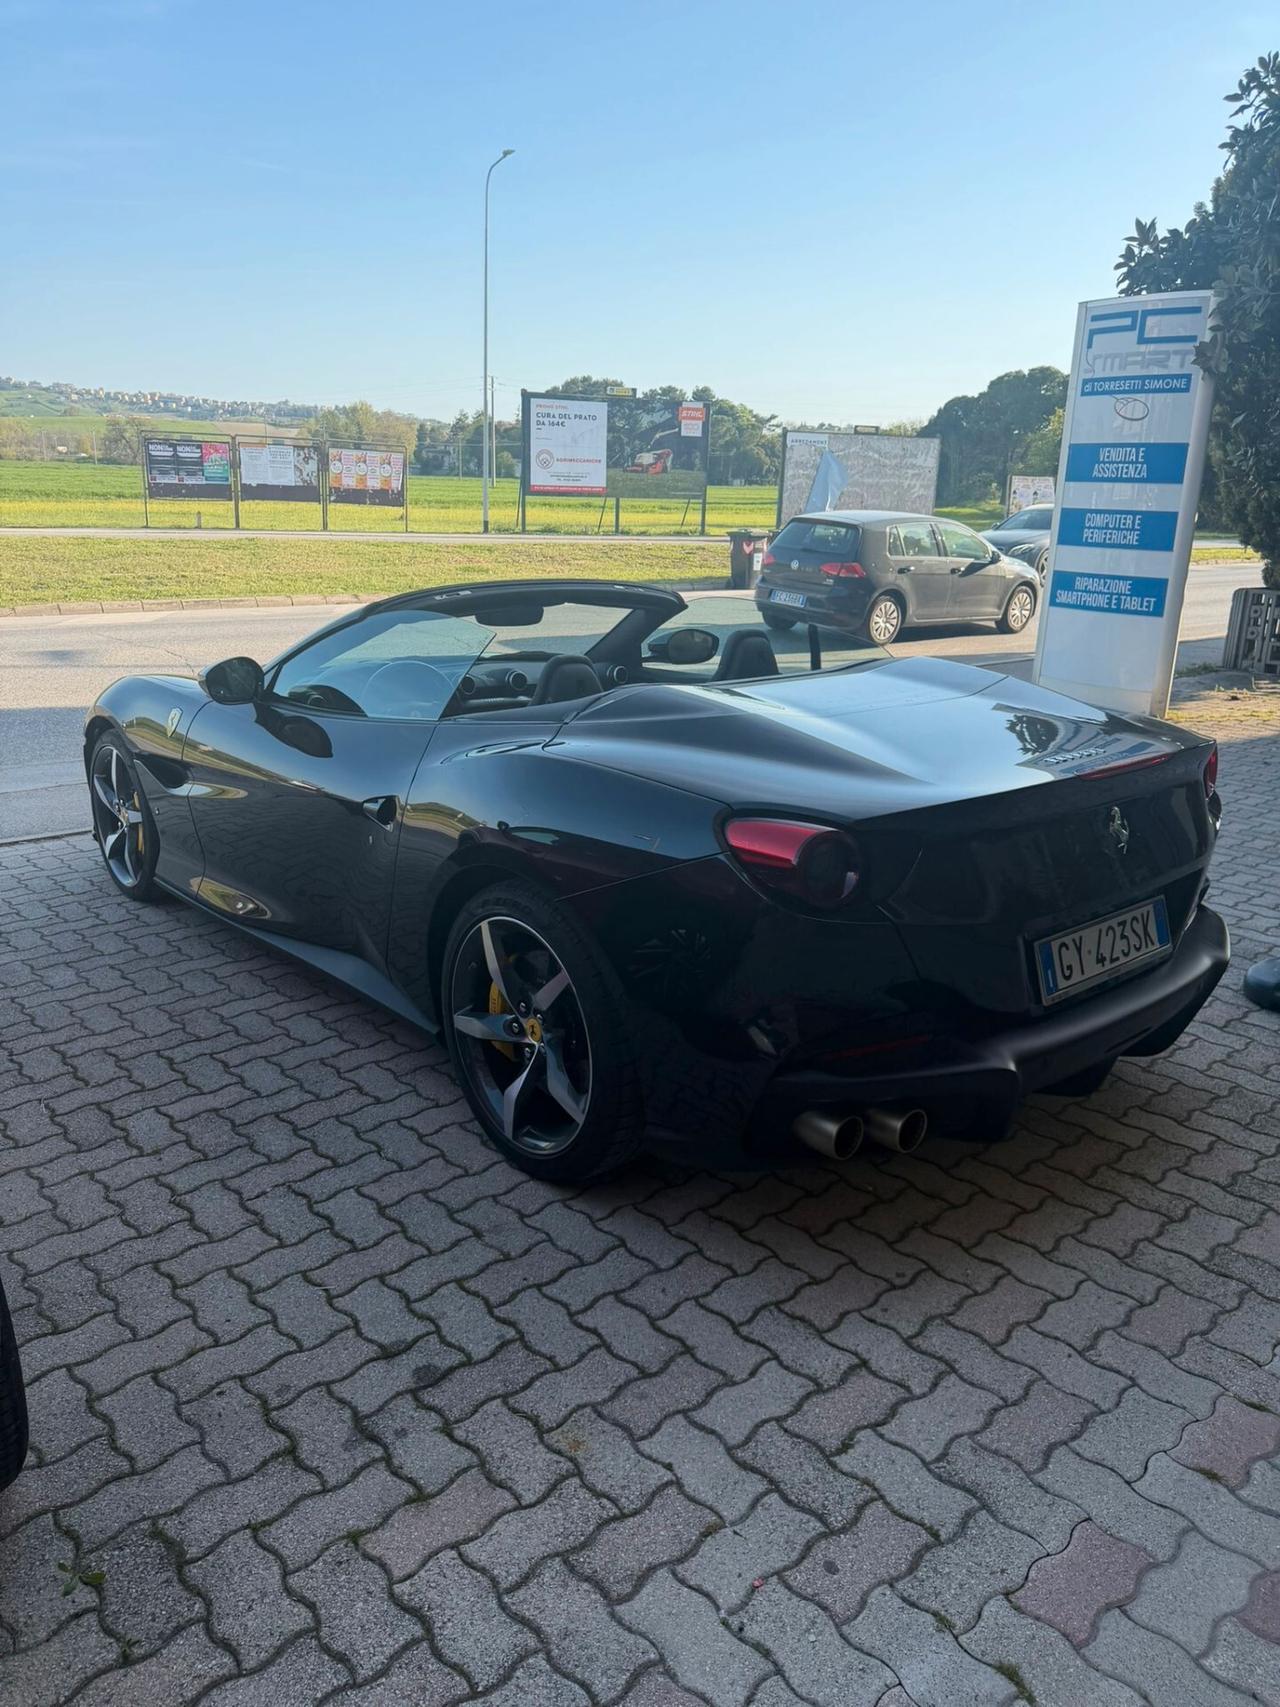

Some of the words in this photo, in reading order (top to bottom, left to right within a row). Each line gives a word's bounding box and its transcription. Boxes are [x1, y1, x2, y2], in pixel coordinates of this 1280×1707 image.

[1087, 306, 1202, 349] PC
[1084, 382, 1092, 392] di
[1094, 379, 1142, 392] TORRESETTI
[1144, 378, 1188, 390] SIMONE
[536, 411, 556, 420] CURA
[573, 413, 597, 421] PRATO
[681, 410, 703, 418] STIHL
[536, 419, 546, 427] DA
[548, 420, 566, 428] 164€
[1099, 447, 1137, 462] VENDITA
[1138, 447, 1146, 462] E
[1092, 463, 1148, 479] ASSISTENZA
[1085, 513, 1133, 529] COMPUTER
[1135, 515, 1142, 530] E
[1082, 528, 1141, 545] PERIFERICHE
[1074, 576, 1133, 595] RIPARAZIONE
[1055, 590, 1110, 609] SMARTPHONE
[1111, 595, 1118, 609] E
[1119, 595, 1157, 612] TABLET
[1058, 935, 1085, 981] GY
[1096, 910, 1154, 967] 423SK
